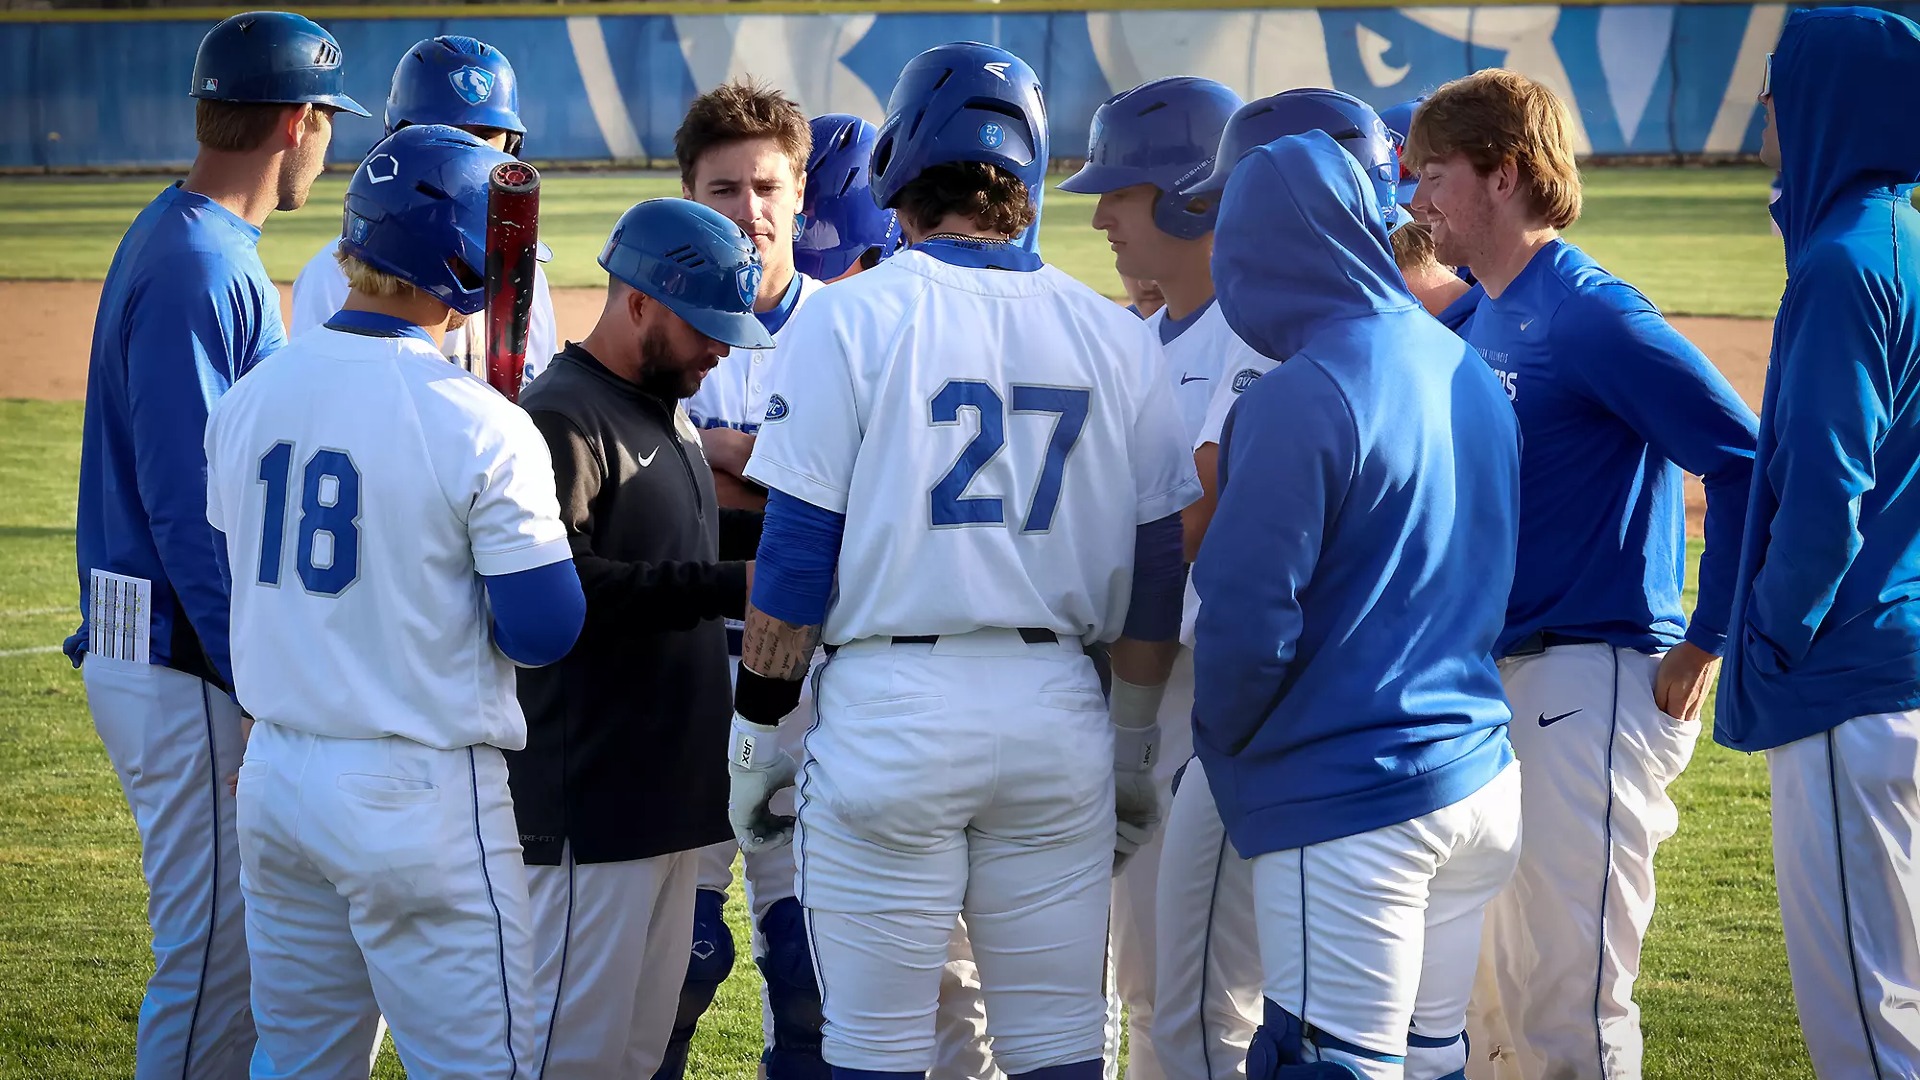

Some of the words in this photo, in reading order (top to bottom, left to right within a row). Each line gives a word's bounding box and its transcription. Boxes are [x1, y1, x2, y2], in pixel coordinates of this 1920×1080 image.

[986, 125, 999, 135] 27
[1174, 155, 1216, 186] EVOSHIELD
[926, 377, 1094, 535] 27
[256, 439, 362, 599] 18
